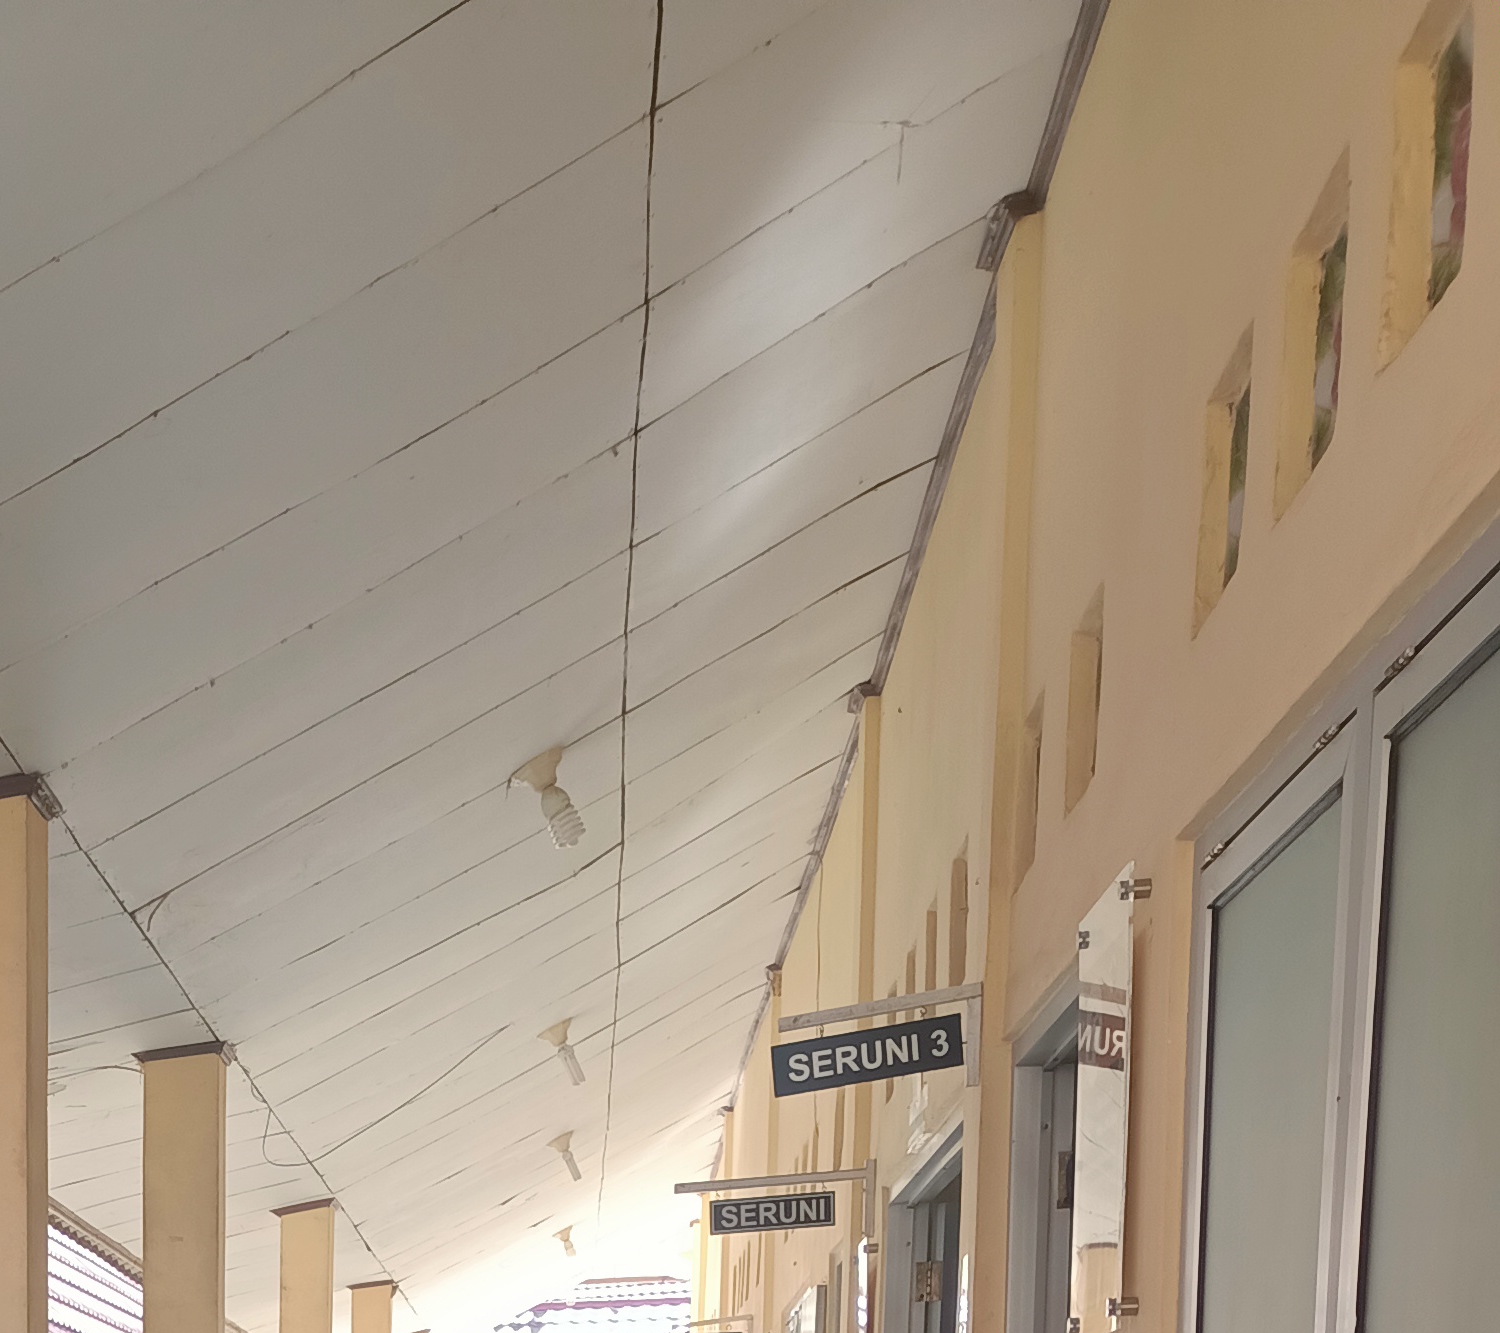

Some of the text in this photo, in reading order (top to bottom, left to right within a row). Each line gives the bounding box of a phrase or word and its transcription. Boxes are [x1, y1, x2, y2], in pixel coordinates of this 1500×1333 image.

[787, 1029, 950, 1083] SERUNI 3
[720, 1199, 826, 1228] SERUNI
